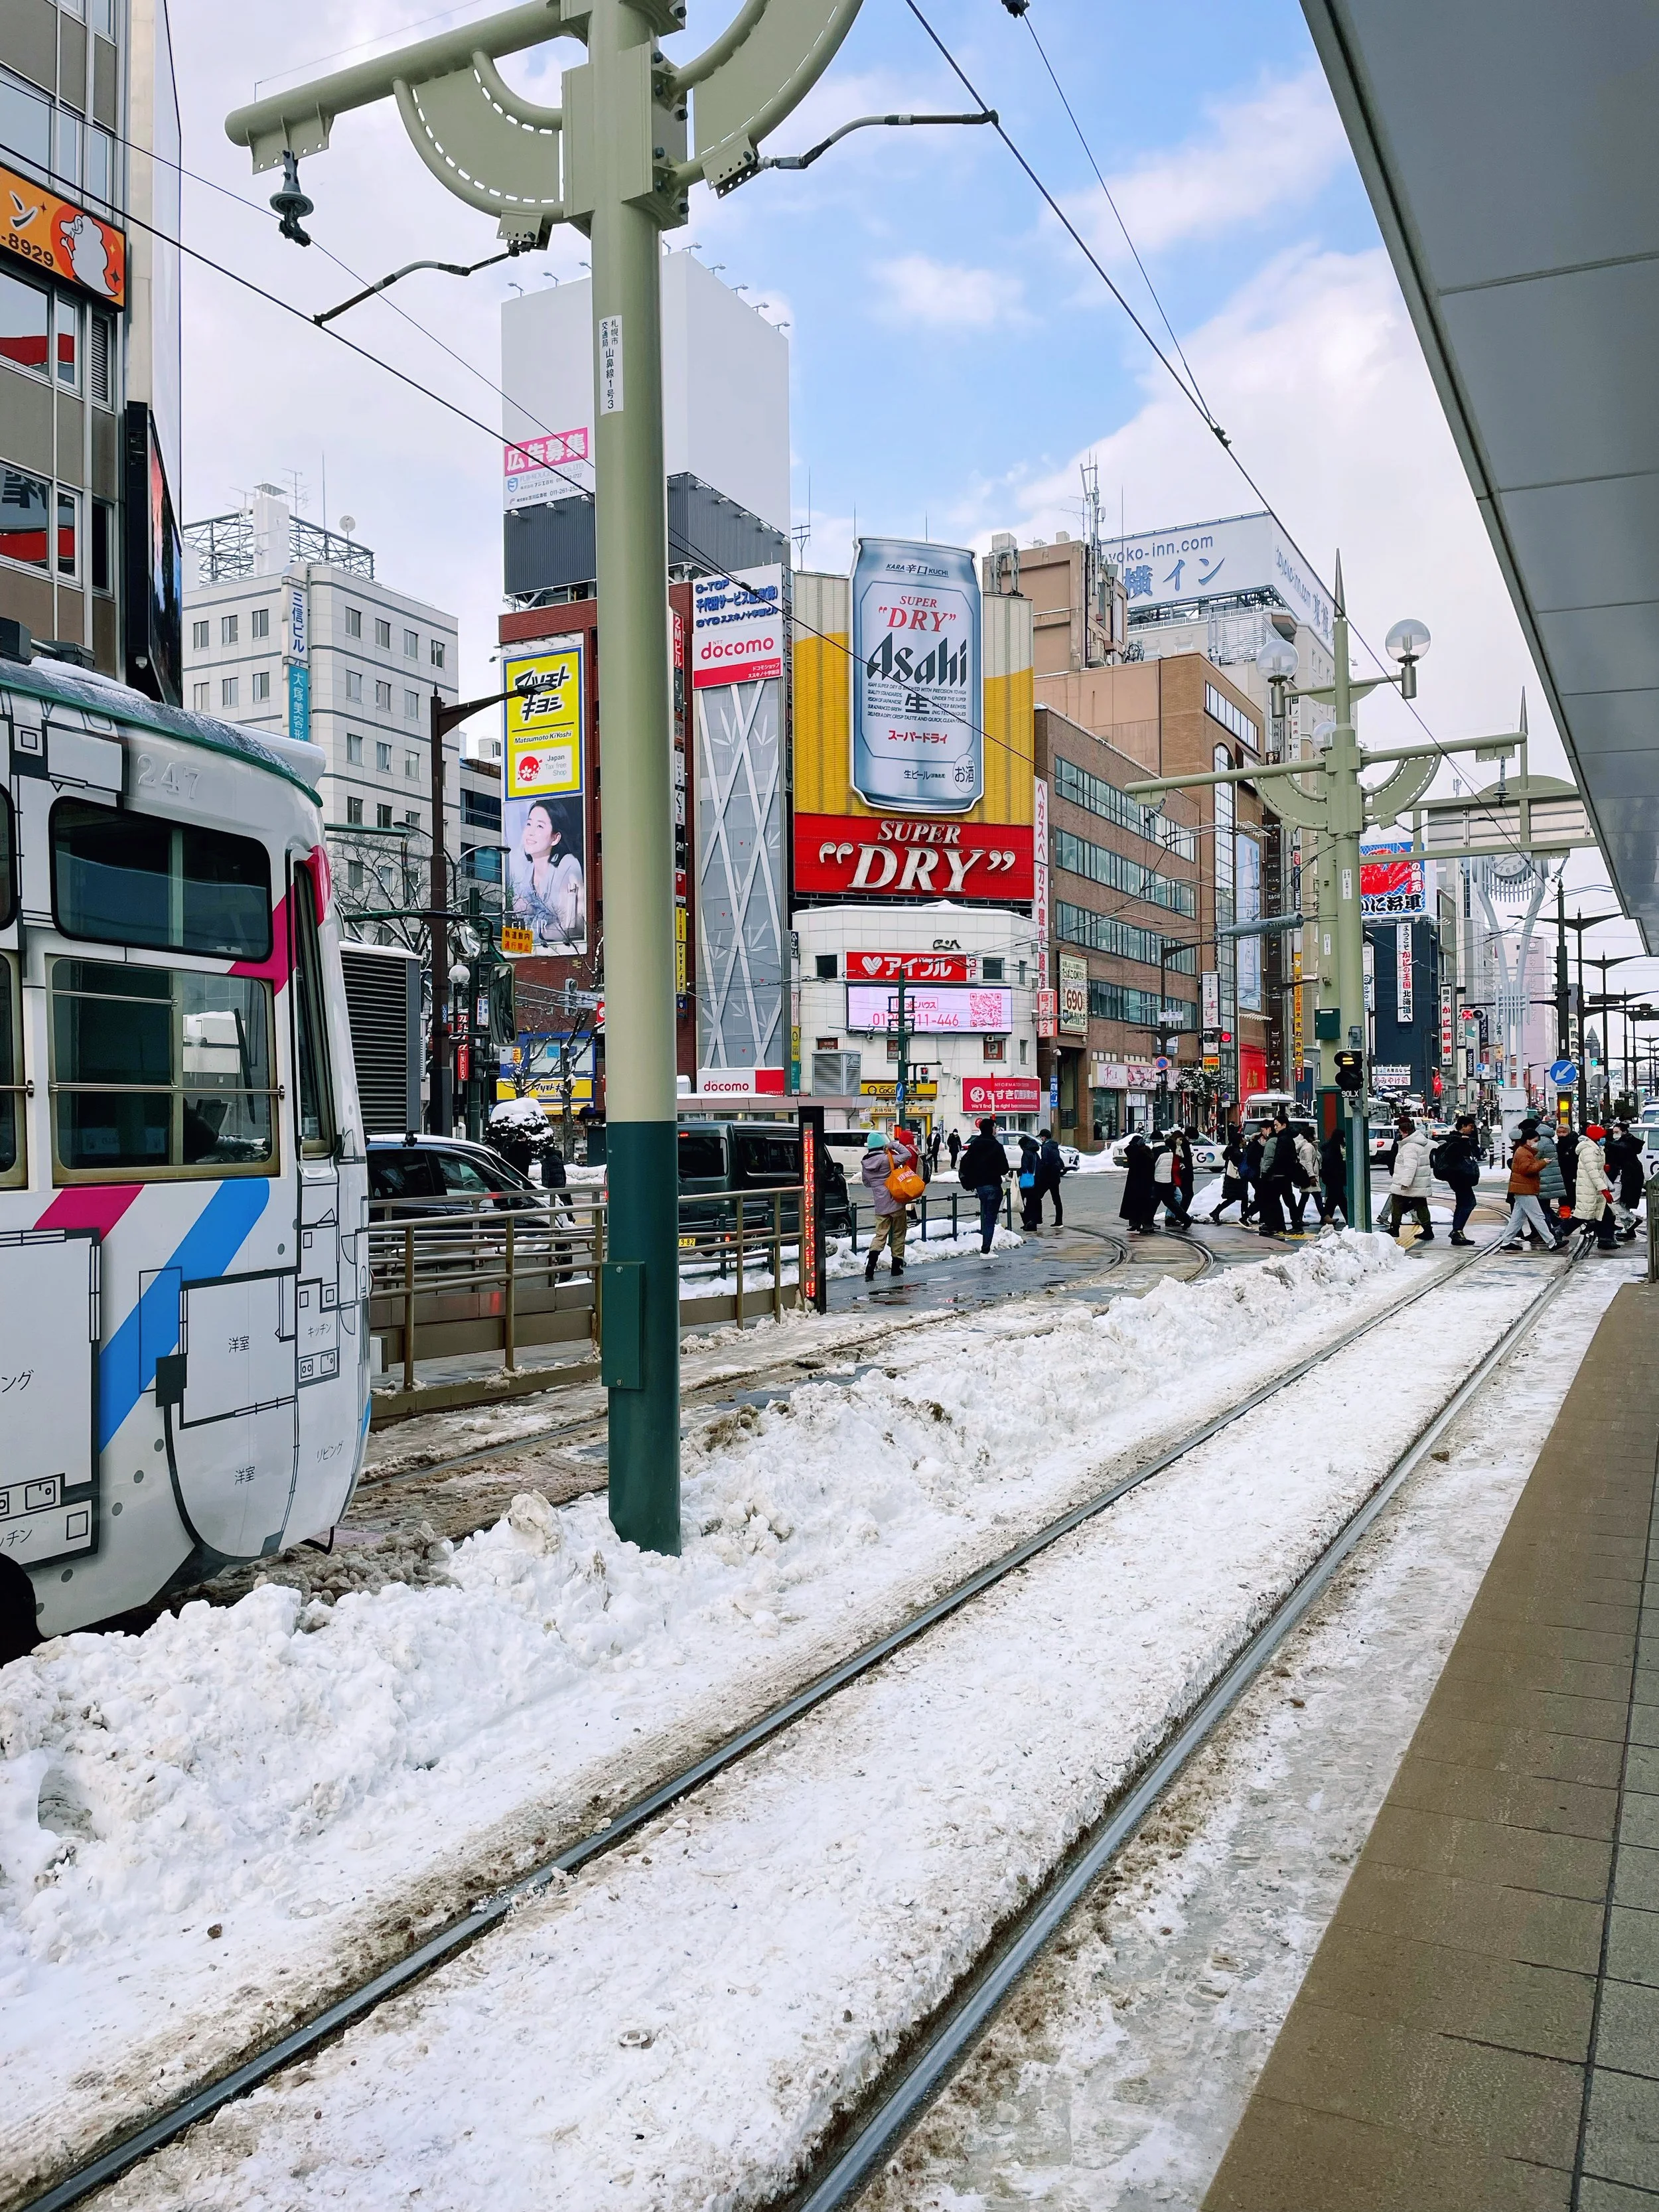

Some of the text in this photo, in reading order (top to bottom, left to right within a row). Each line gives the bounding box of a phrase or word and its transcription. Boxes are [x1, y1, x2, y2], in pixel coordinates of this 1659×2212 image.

[606, 348, 614, 409] 山鼻線1号3
[507, 433, 585, 472] 広告募集
[906, 564, 928, 575] 辛口
[900, 596, 937, 608] SUPER
[293, 592, 305, 653] 三信ビル
[701, 637, 774, 660] docomo
[753, 662, 779, 671] ドコモショップ
[867, 632, 966, 687] Asahi
[515, 666, 569, 687] マツモト
[522, 694, 562, 721] キヨシ
[905, 694, 930, 714] 生
[514, 734, 549, 744] Matsumoto
[888, 730, 947, 744] スーパードライ
[137, 754, 200, 800] 247
[955, 766, 974, 782] お酒
[877, 820, 961, 844] SUPER
[504, 941, 530, 952] 通行禁止
[884, 956, 952, 978] アイフル
[1402, 924, 1411, 1021] ようこそかにの王国北海道へ
[1067, 989, 1082, 1011] 690
[873, 1013, 959, 1027] 01211-446
[704, 1081, 749, 1092] docomo
[1196, 1152, 1215, 1163] GO
[307, 1323, 331, 1337] キッチン
[228, 1335, 250, 1353] 洋室
[1, 1370, 34, 1393] ング
[317, 1440, 344, 1463] リビング
[235, 1465, 255, 1485] 洋室
